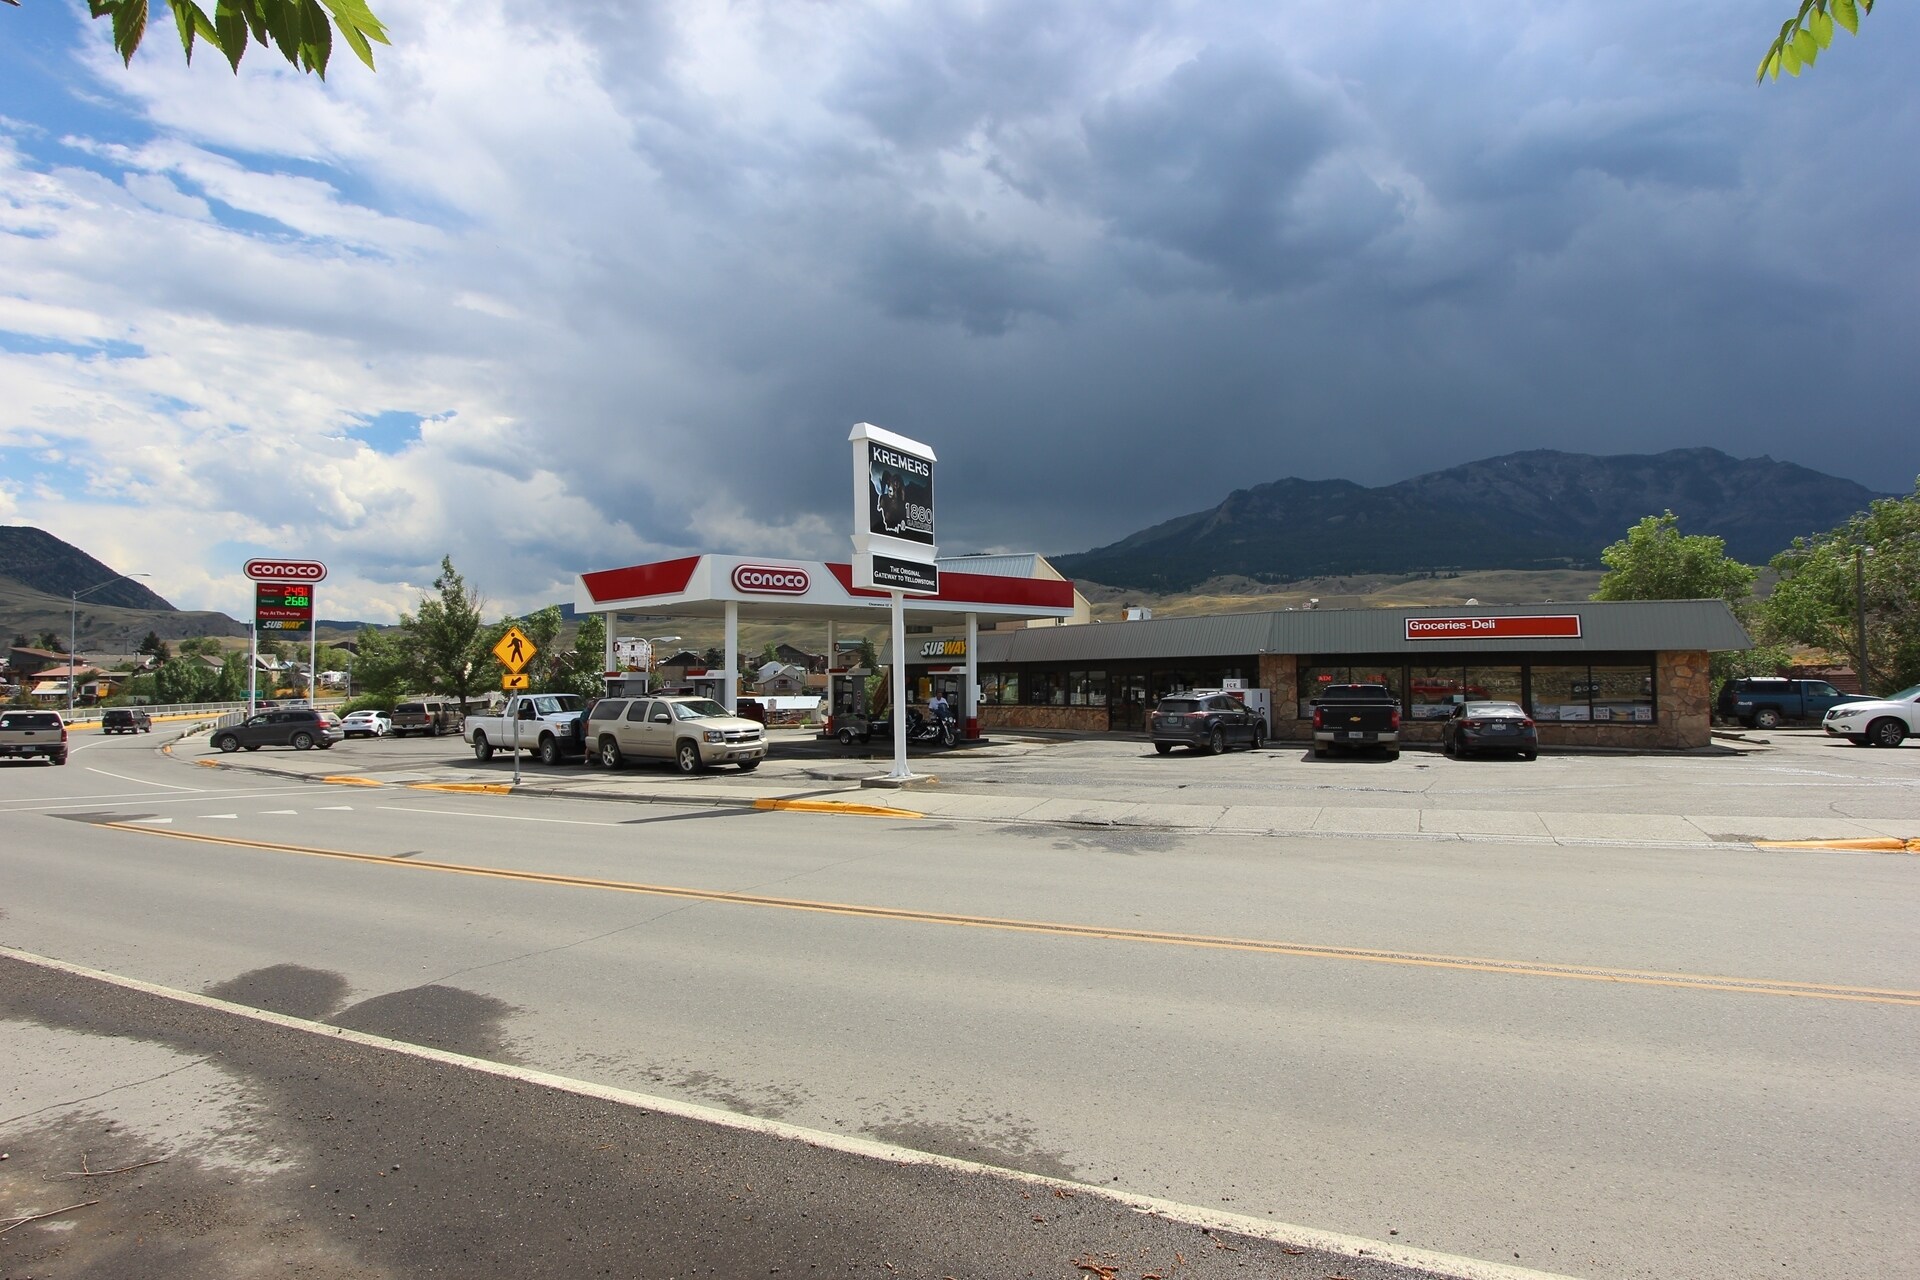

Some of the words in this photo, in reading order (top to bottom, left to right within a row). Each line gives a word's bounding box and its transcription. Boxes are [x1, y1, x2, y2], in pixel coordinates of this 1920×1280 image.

[872, 446, 929, 477] KREMERS
[905, 502, 932, 525] 1880
[889, 565, 899, 574] THE
[900, 567, 921, 577] ORIGINAL
[874, 570, 897, 581] GATEWAY
[904, 574, 935, 587] YELLOWSTONE
[262, 621, 305, 629] SUBWAY
[1409, 619, 1496, 631] Groceries-Deli
